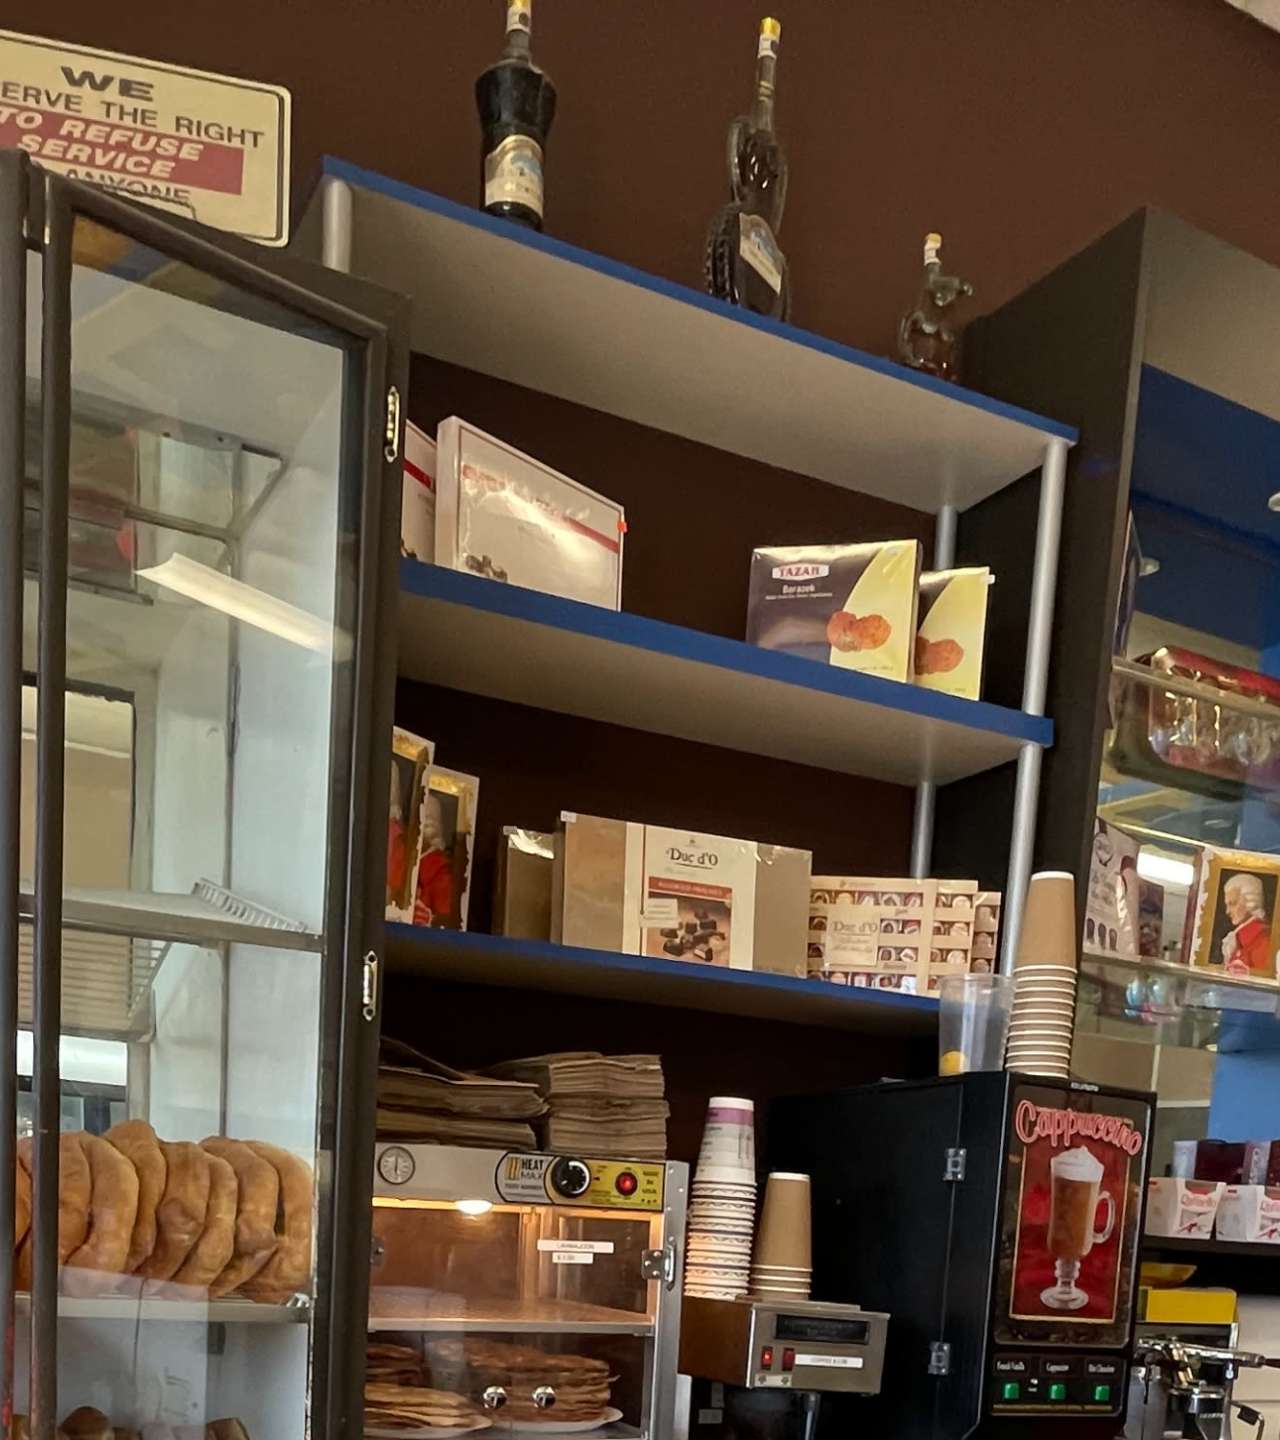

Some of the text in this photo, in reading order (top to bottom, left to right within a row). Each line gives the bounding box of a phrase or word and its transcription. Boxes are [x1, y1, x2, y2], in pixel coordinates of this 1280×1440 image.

[60, 66, 154, 101] WE
[59, 119, 205, 162] REFUSE
[100, 100, 158, 128] THE
[175, 116, 265, 149] RIGHT
[17, 133, 177, 178] SERVICE
[669, 847, 719, 867] Duc d'O
[1015, 1100, 1143, 1156] Cappuccino
[521, 1159, 544, 1171] HEAT
